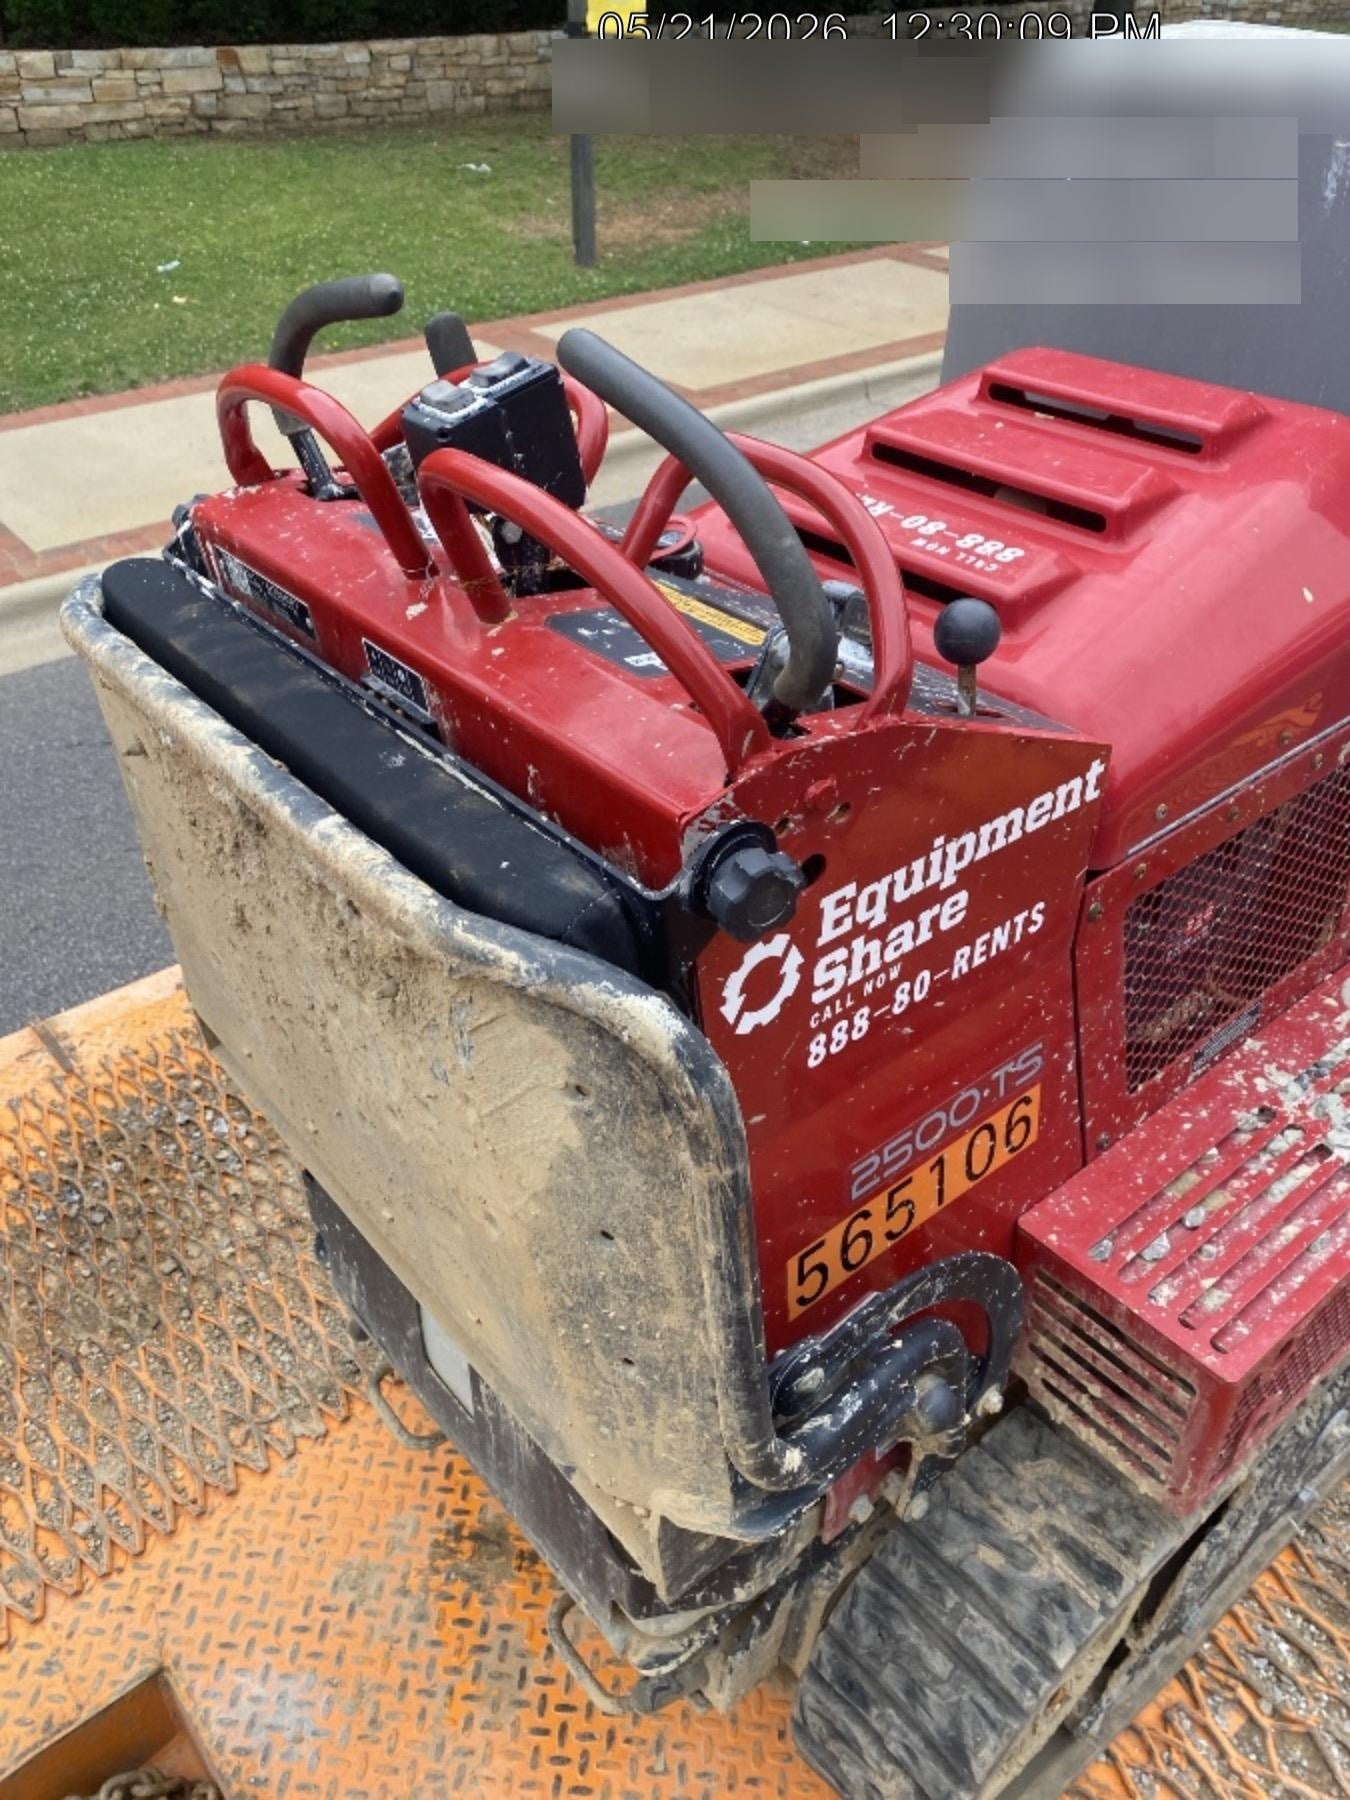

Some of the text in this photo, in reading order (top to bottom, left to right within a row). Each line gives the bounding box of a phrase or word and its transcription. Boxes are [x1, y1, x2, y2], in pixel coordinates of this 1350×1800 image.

[816, 759, 1105, 947] Equipment
[807, 901, 1047, 1069] 888-80-RENTS
[809, 964, 903, 1029] CALL NOW
[811, 889, 970, 1004] Share
[795, 1095, 1033, 1308] 565106
